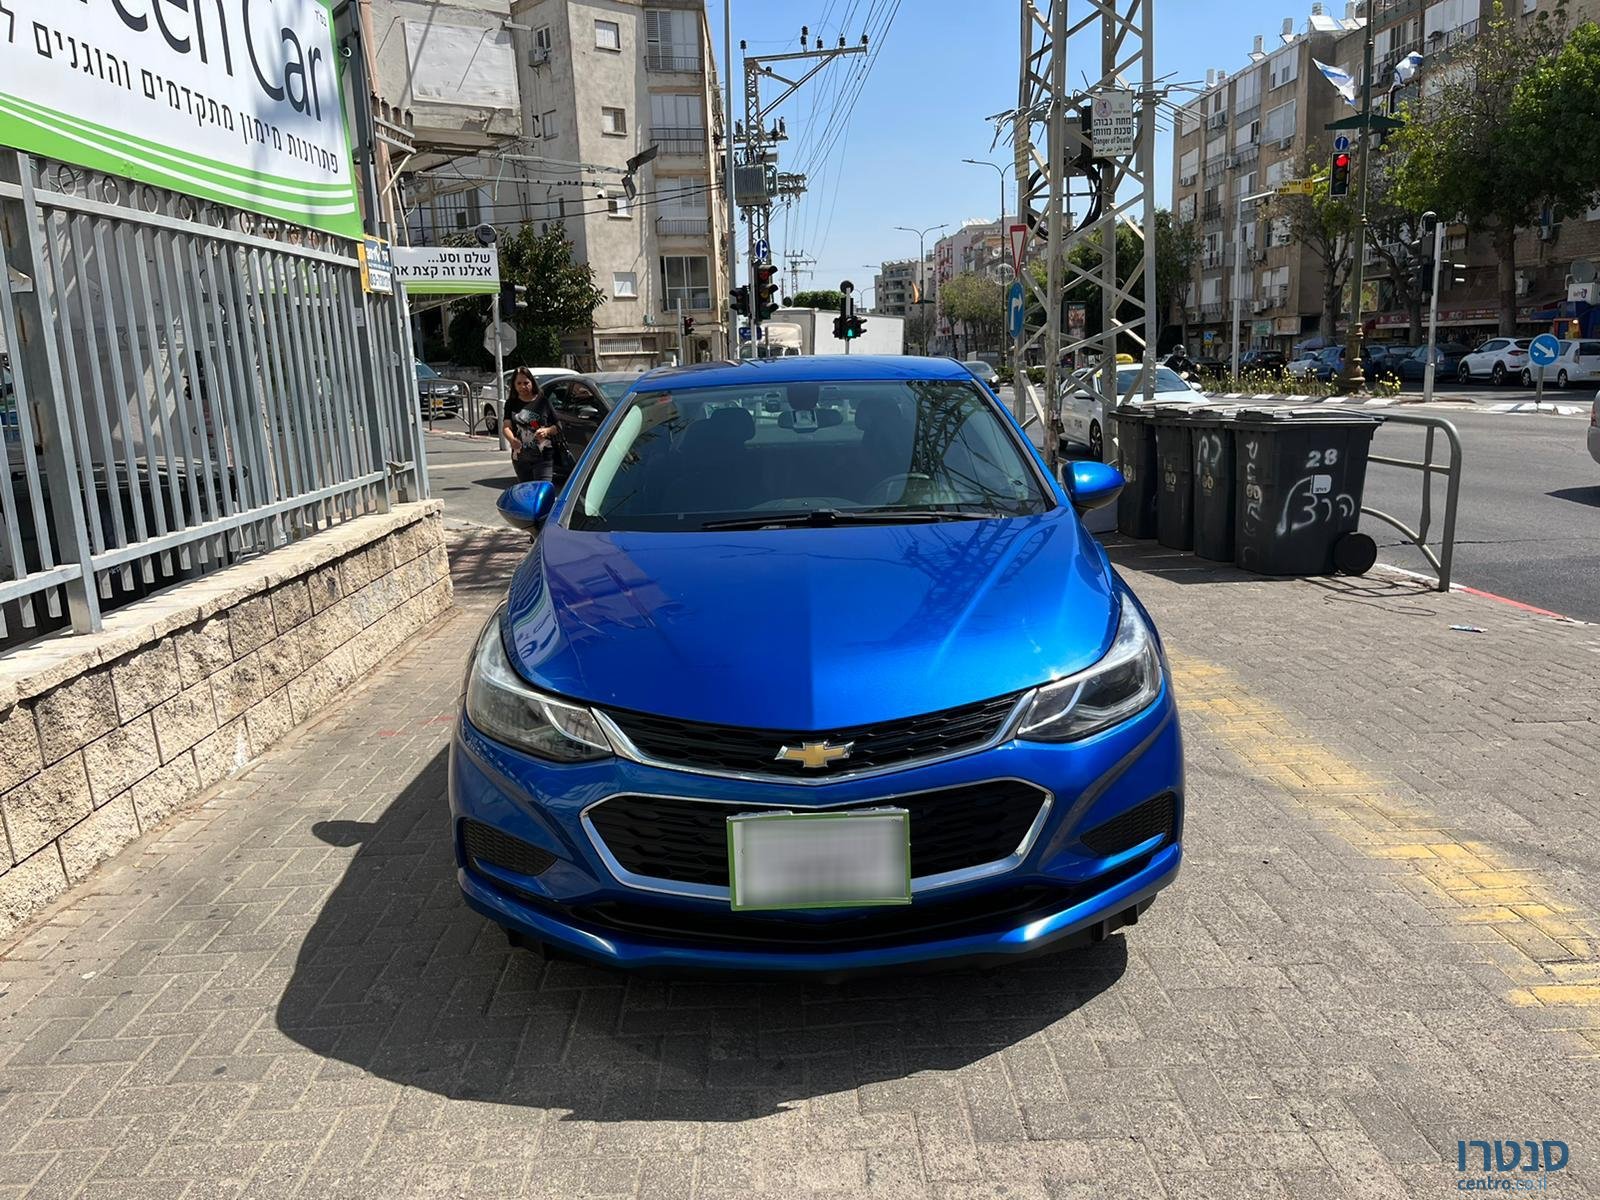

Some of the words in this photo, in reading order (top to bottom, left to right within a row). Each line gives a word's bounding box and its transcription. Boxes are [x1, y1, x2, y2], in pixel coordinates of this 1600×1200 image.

[32, 21, 131, 90] והוגנים
[242, 0, 322, 121] Car
[141, 69, 234, 131] מתקדמים
[240, 112, 282, 151] מימון
[1114, 127, 1131, 135] סכנת
[1094, 137, 1110, 146] Danger
[1110, 136, 1116, 144] of
[287, 133, 338, 173] פתרונות
[428, 253, 460, 263] וסע...
[464, 252, 490, 263] שלם
[413, 266, 438, 278] קצת
[442, 266, 456, 276] זה
[460, 264, 492, 276] אצלנו
[1305, 448, 1338, 468] 28
